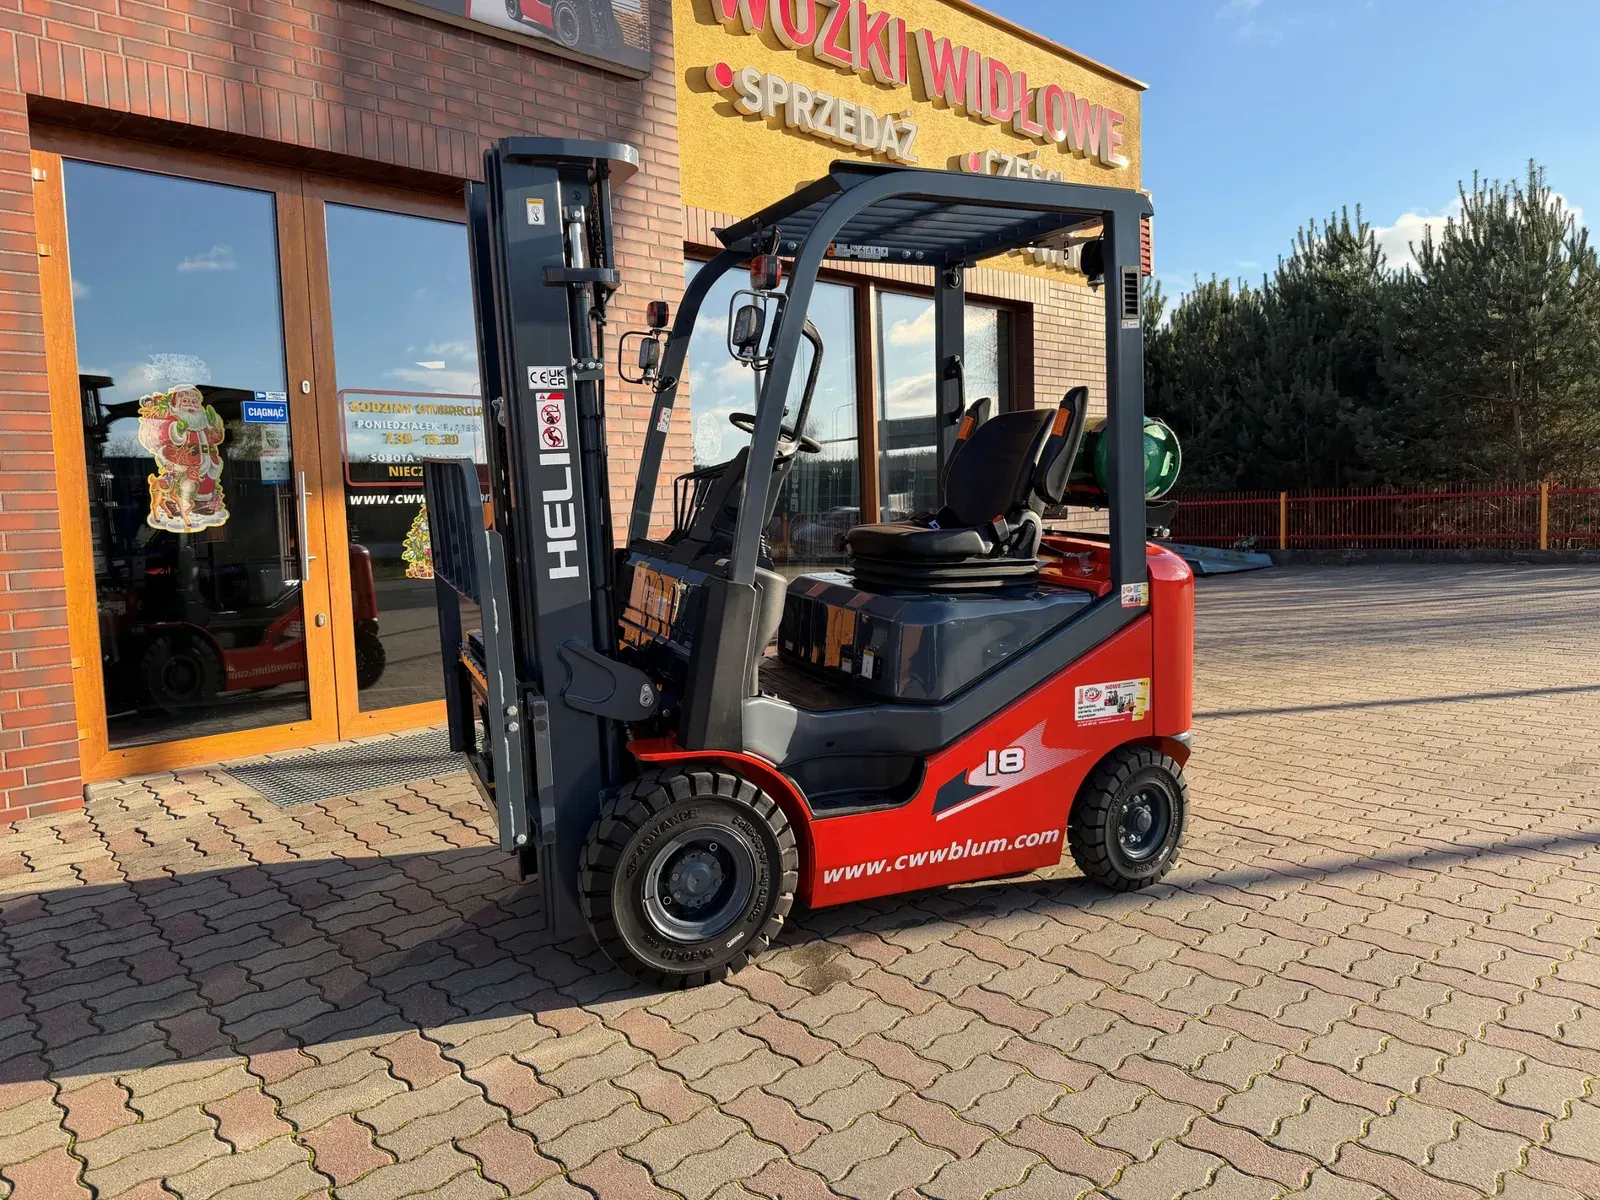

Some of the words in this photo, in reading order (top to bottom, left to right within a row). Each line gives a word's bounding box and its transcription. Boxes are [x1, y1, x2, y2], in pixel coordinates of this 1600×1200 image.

[733, 67, 918, 164] SPRZEDAŻ
[916, 28, 1129, 168] WIDŁOWE
[248, 406, 284, 419] CIĄGNĄĆ
[350, 401, 412, 414] GODZINY
[370, 453, 414, 463] SOBOTA
[539, 452, 580, 580] HELI
[986, 747, 1026, 776] 18
[823, 828, 1060, 885] www.cwwblum.com
